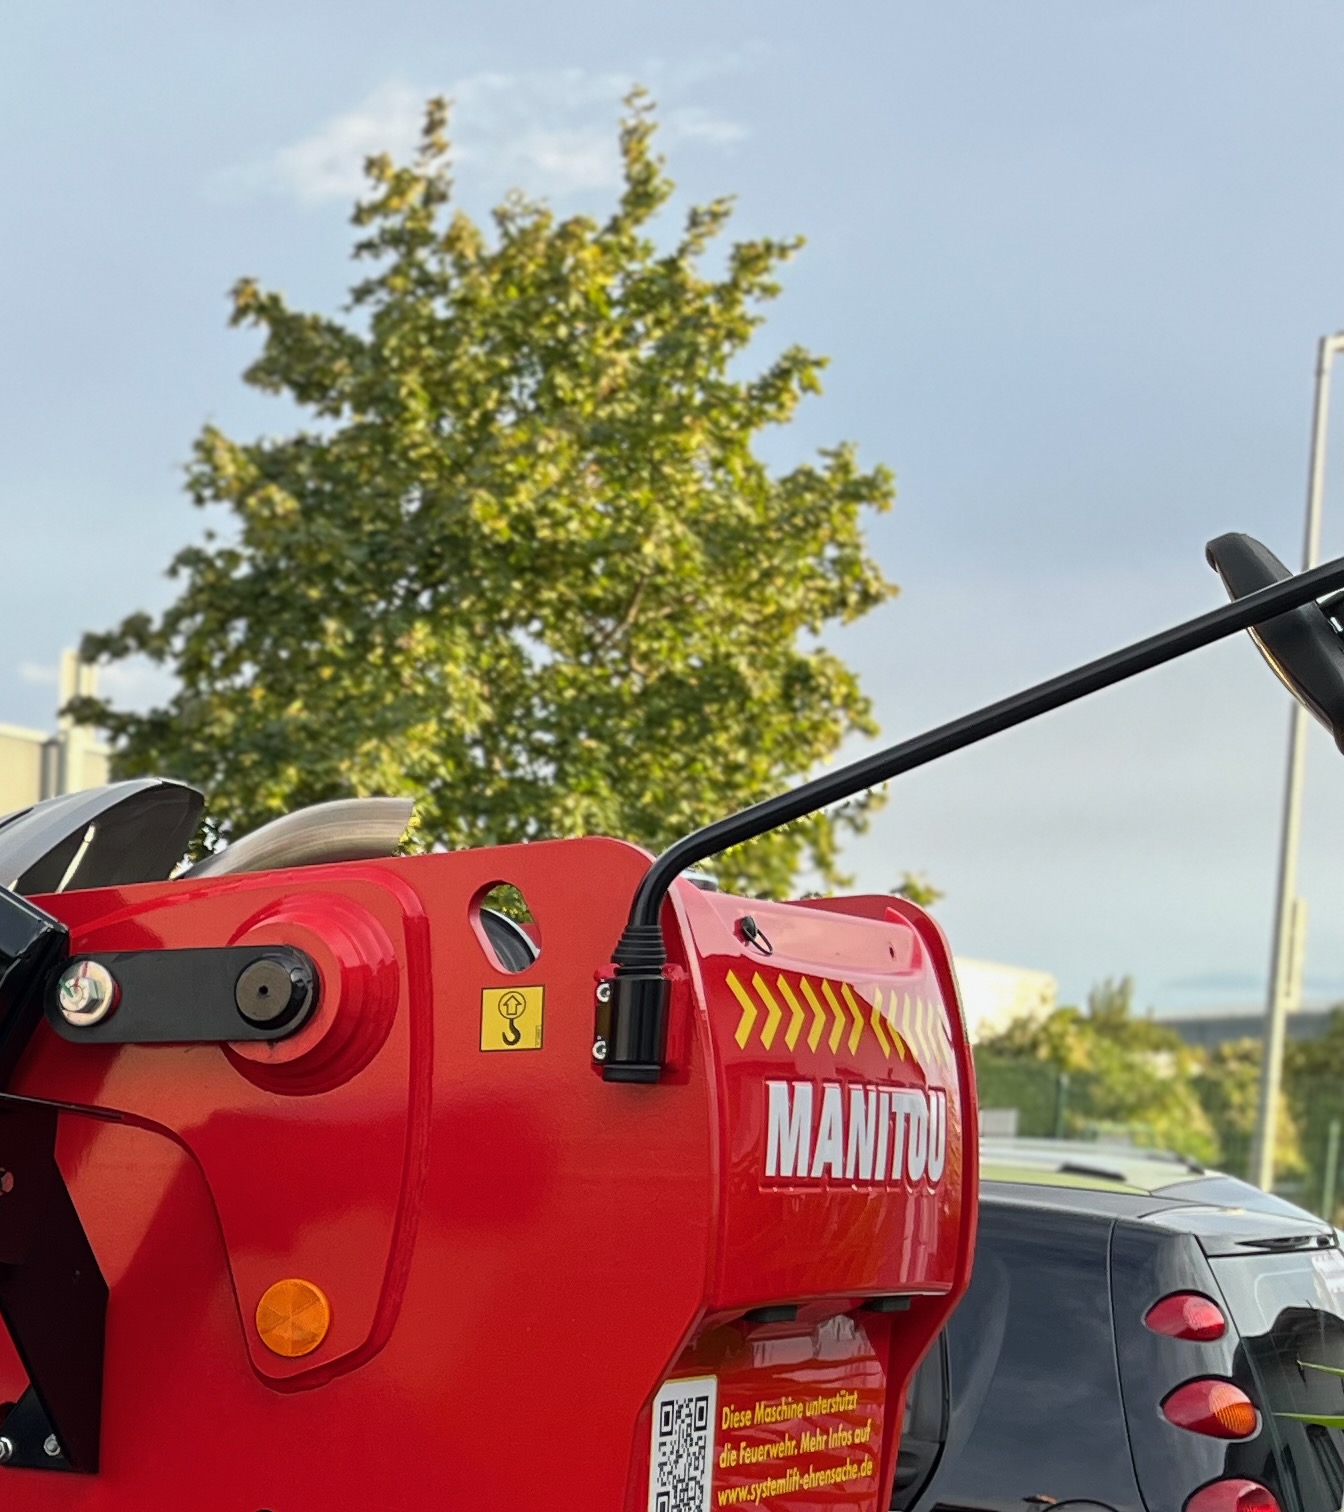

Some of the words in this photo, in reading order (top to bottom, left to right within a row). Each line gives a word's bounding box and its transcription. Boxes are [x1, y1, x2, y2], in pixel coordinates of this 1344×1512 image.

[765, 1081, 946, 1182] MANITOU
[721, 1404, 752, 1430] Diese
[754, 1396, 804, 1425] Maschine
[805, 1389, 859, 1417] unterstützt
[719, 1442, 737, 1468] die
[739, 1433, 798, 1465] Feuerwehr.
[800, 1427, 827, 1454] Mehr
[828, 1423, 852, 1449] Infos
[853, 1418, 872, 1444] auf
[717, 1453, 874, 1507] www.systemlift-ehrensache.de
